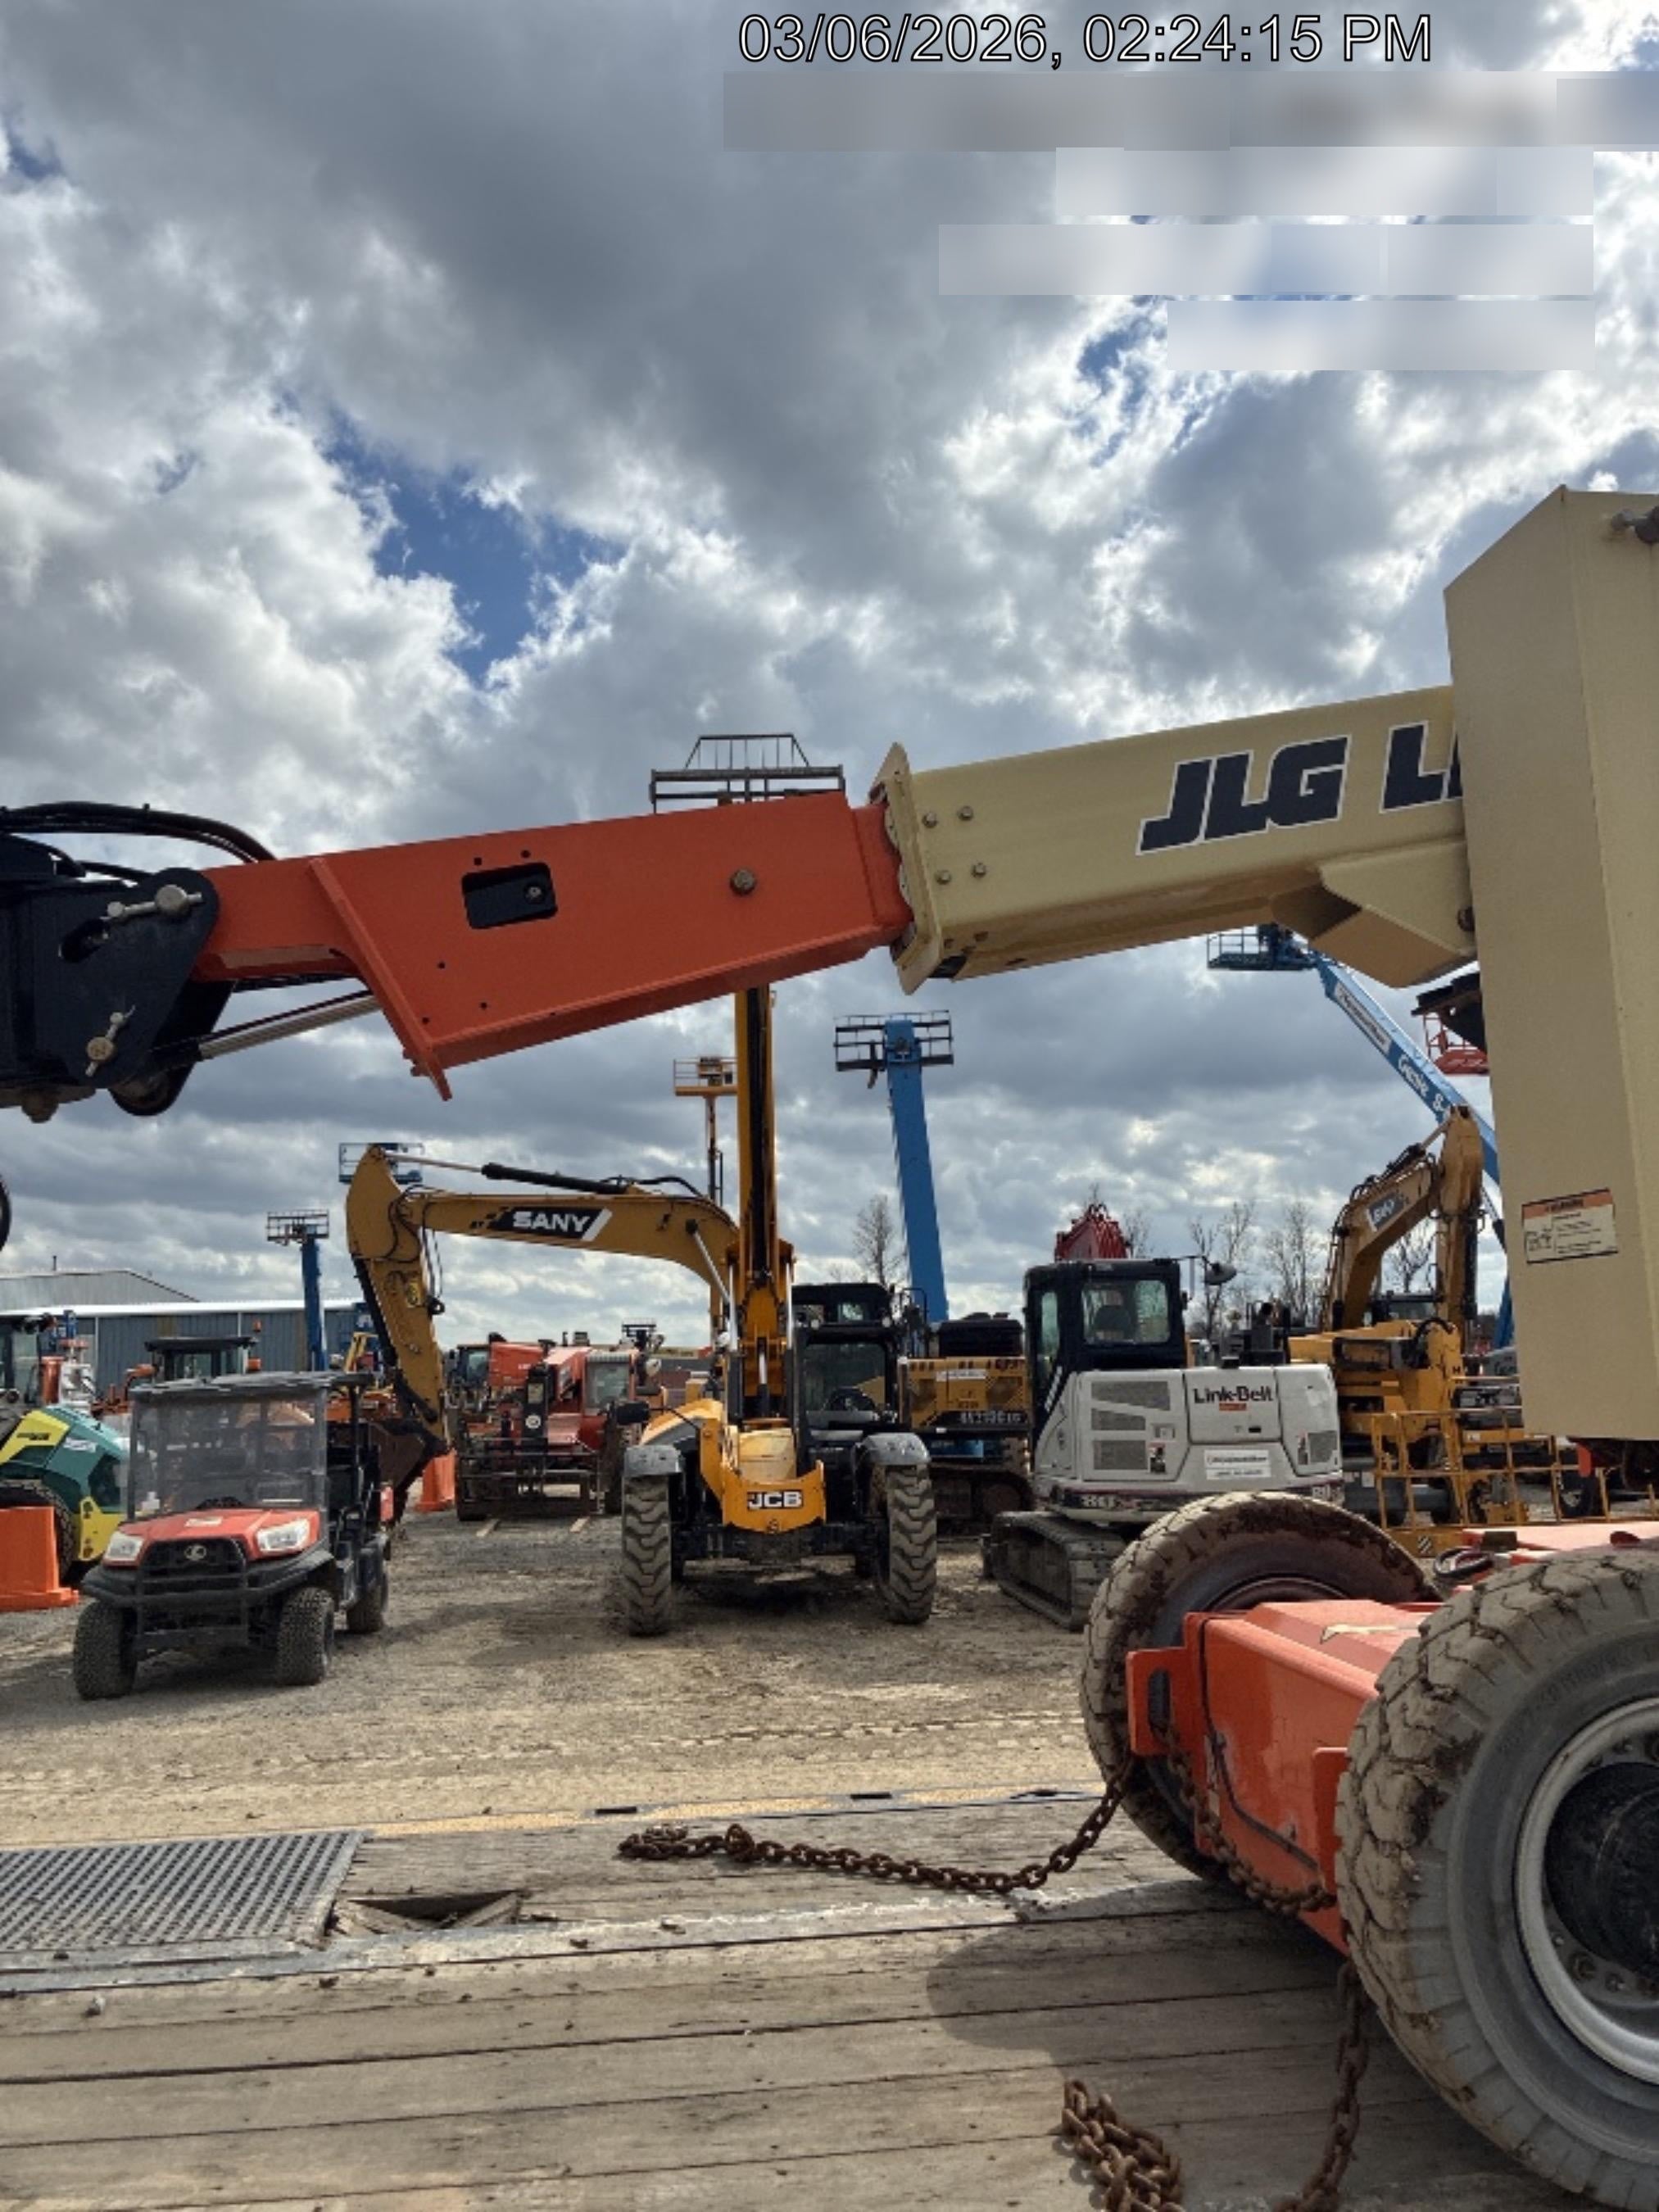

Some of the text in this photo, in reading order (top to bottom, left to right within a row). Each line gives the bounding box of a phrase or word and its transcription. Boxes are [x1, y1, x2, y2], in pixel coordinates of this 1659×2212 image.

[1135, 735, 1352, 855] JLG
[513, 1210, 590, 1232] SANY
[1193, 1385, 1273, 1403] Link-Belt
[747, 1490, 803, 1510] JCB
